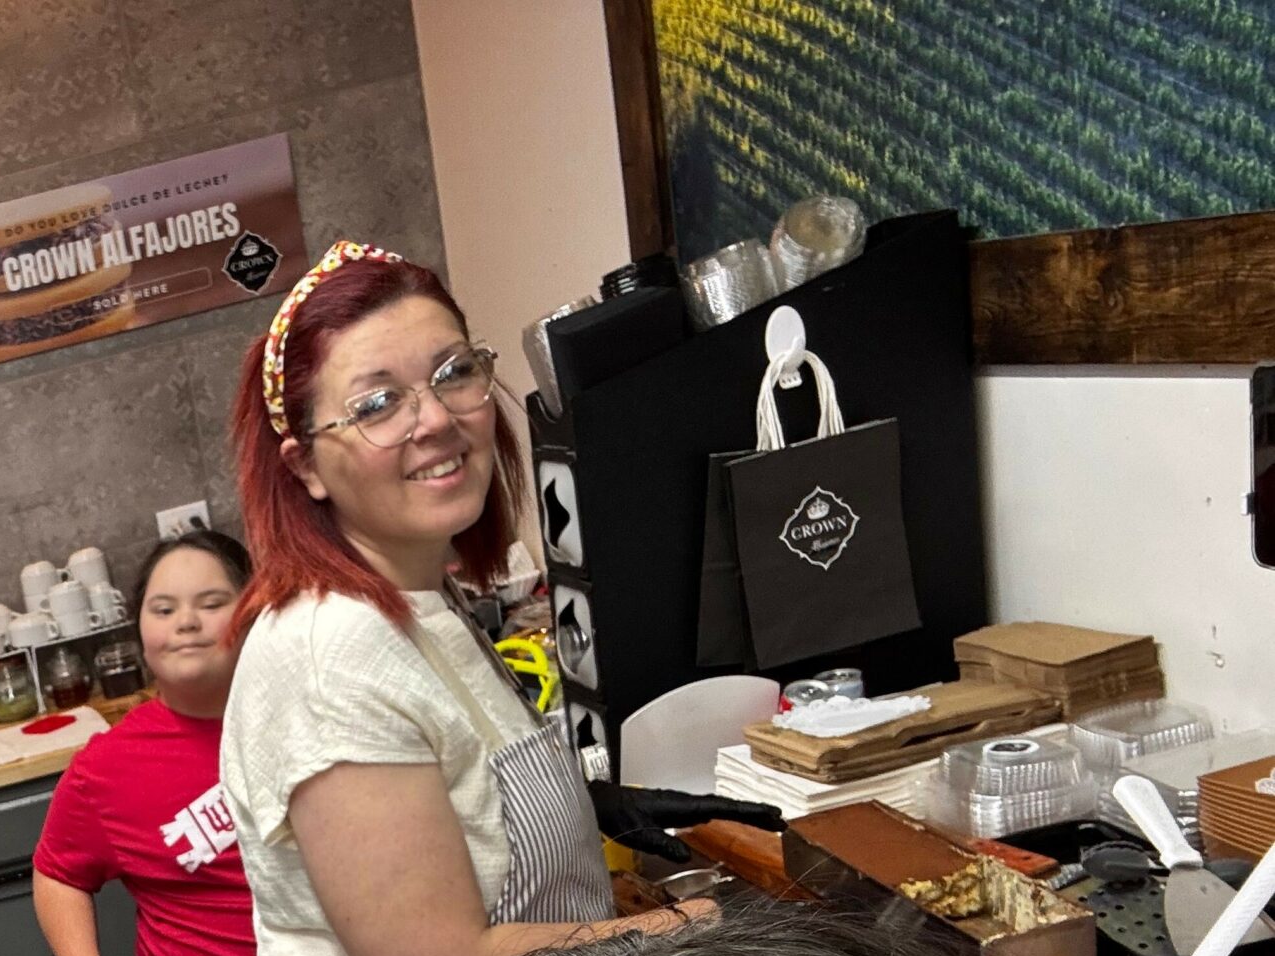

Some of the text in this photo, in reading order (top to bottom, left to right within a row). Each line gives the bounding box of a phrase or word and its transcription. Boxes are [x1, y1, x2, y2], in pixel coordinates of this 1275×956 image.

[5, 174, 229, 238] DO YOU LOVE DULCE DE LECHE?
[2, 202, 241, 292] CROWN ALFAJORES
[92, 283, 168, 311] SOLD HERE
[790, 515, 847, 541] CROWN
